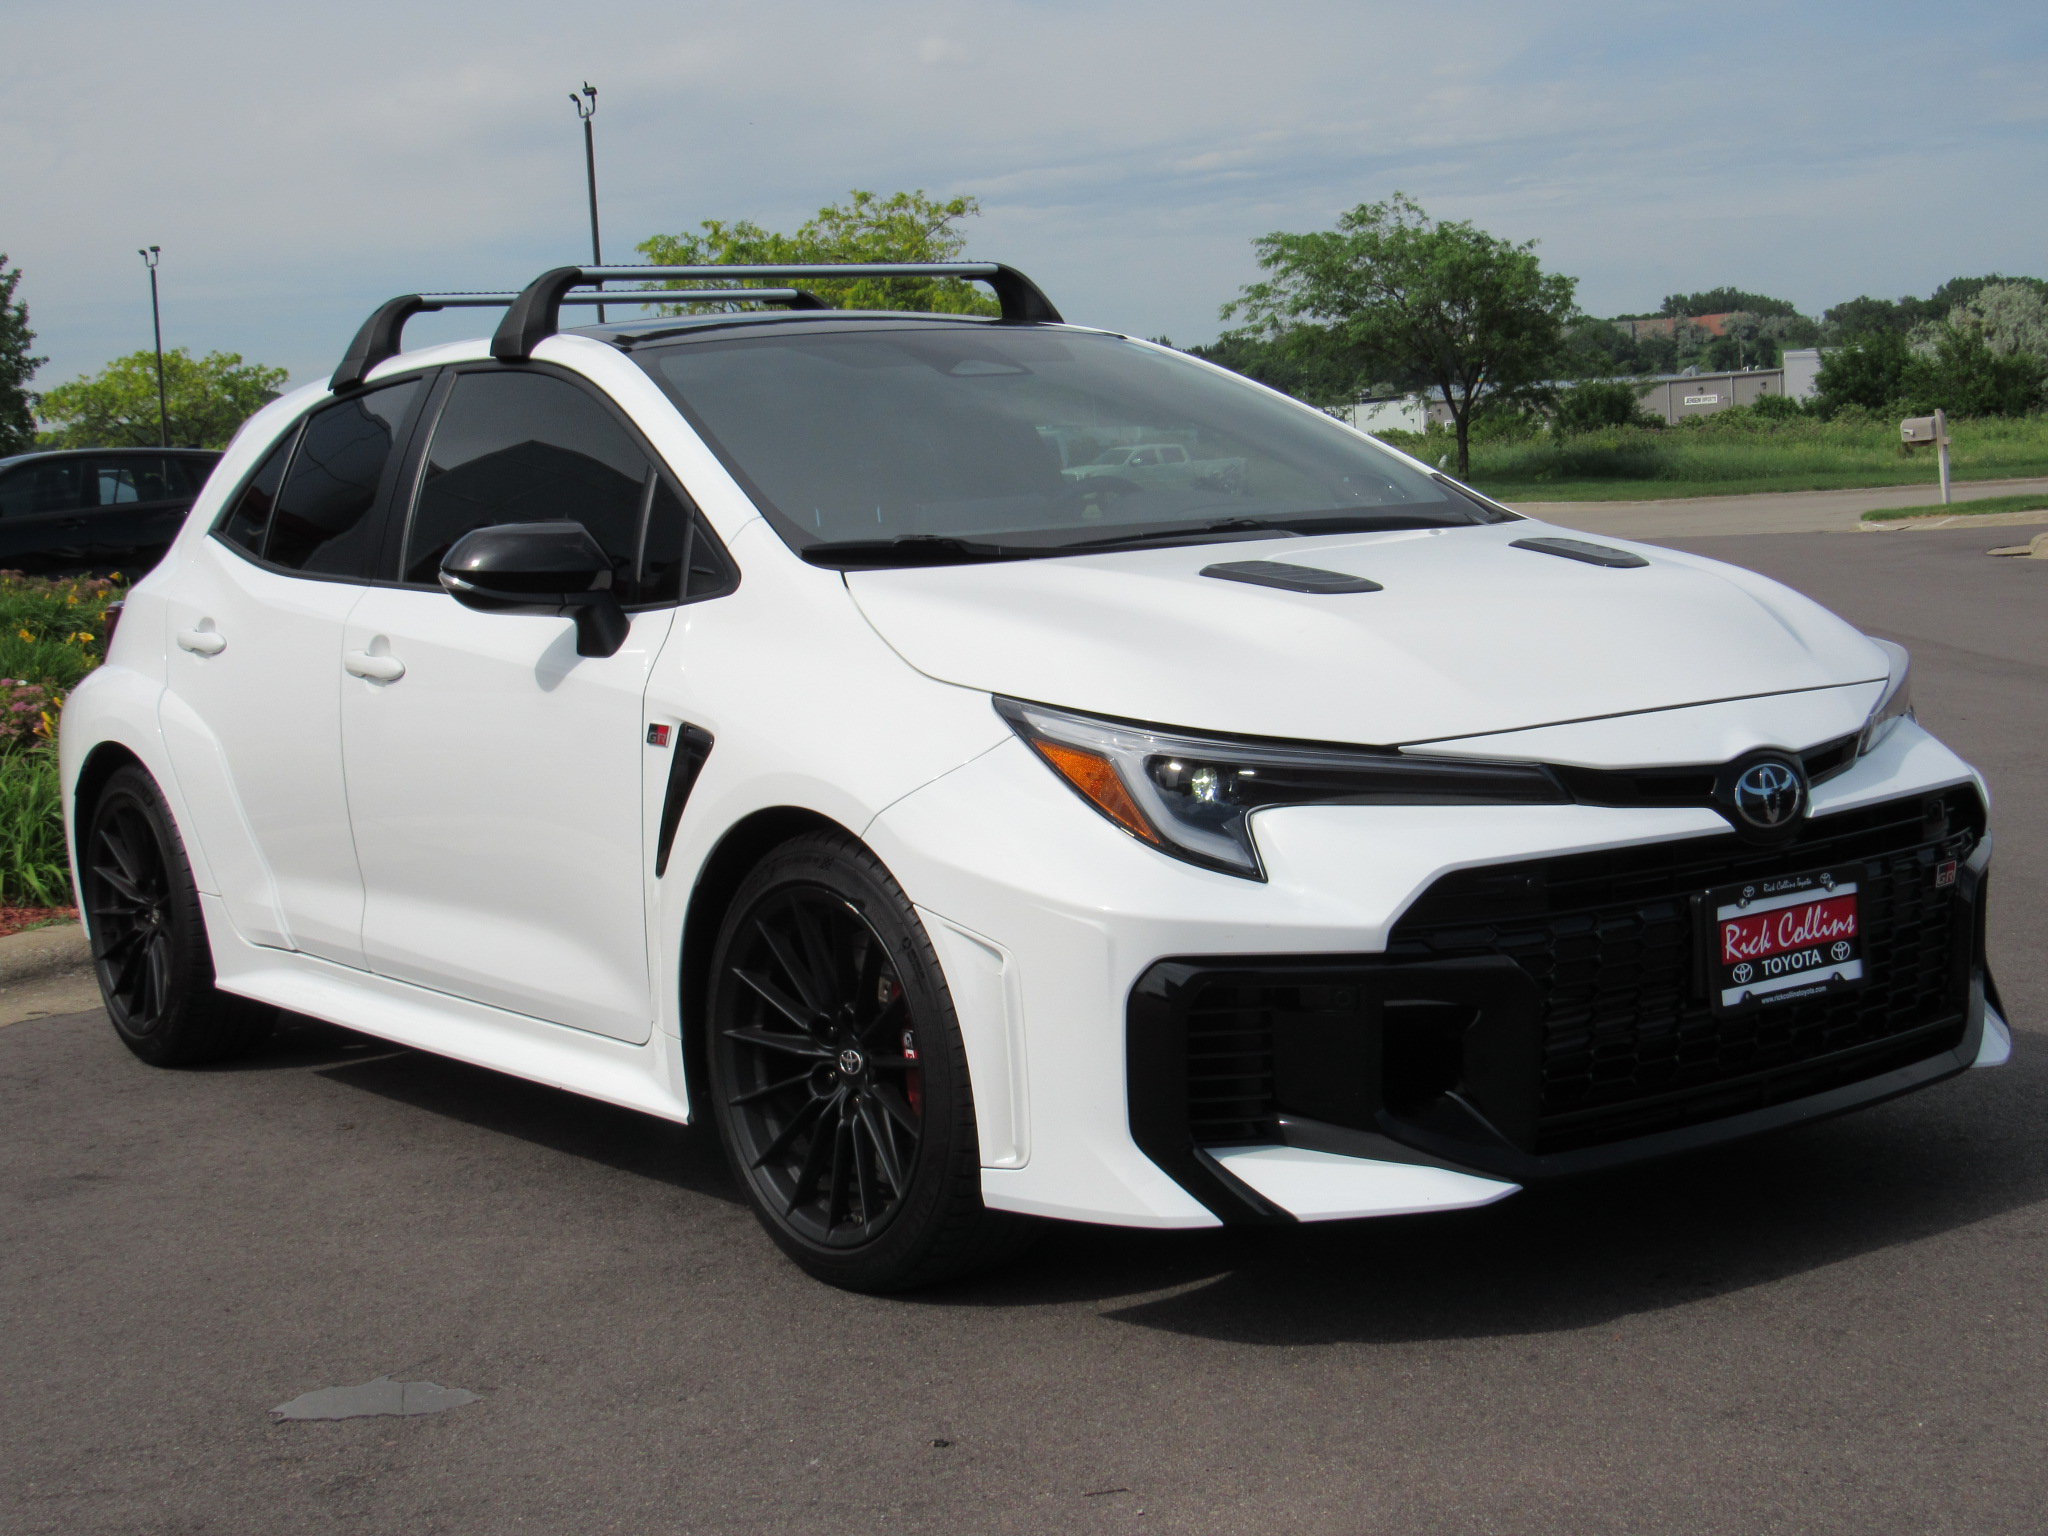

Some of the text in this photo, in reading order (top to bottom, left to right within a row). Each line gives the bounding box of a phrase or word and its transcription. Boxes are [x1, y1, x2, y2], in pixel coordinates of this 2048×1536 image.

[648, 732, 666, 744] GR
[1763, 877, 1812, 893] Rick Collins Toyota
[1936, 869, 1954, 885] GR
[1725, 905, 1855, 960] Rick Collins
[1762, 949, 1822, 976] TOYOTA
